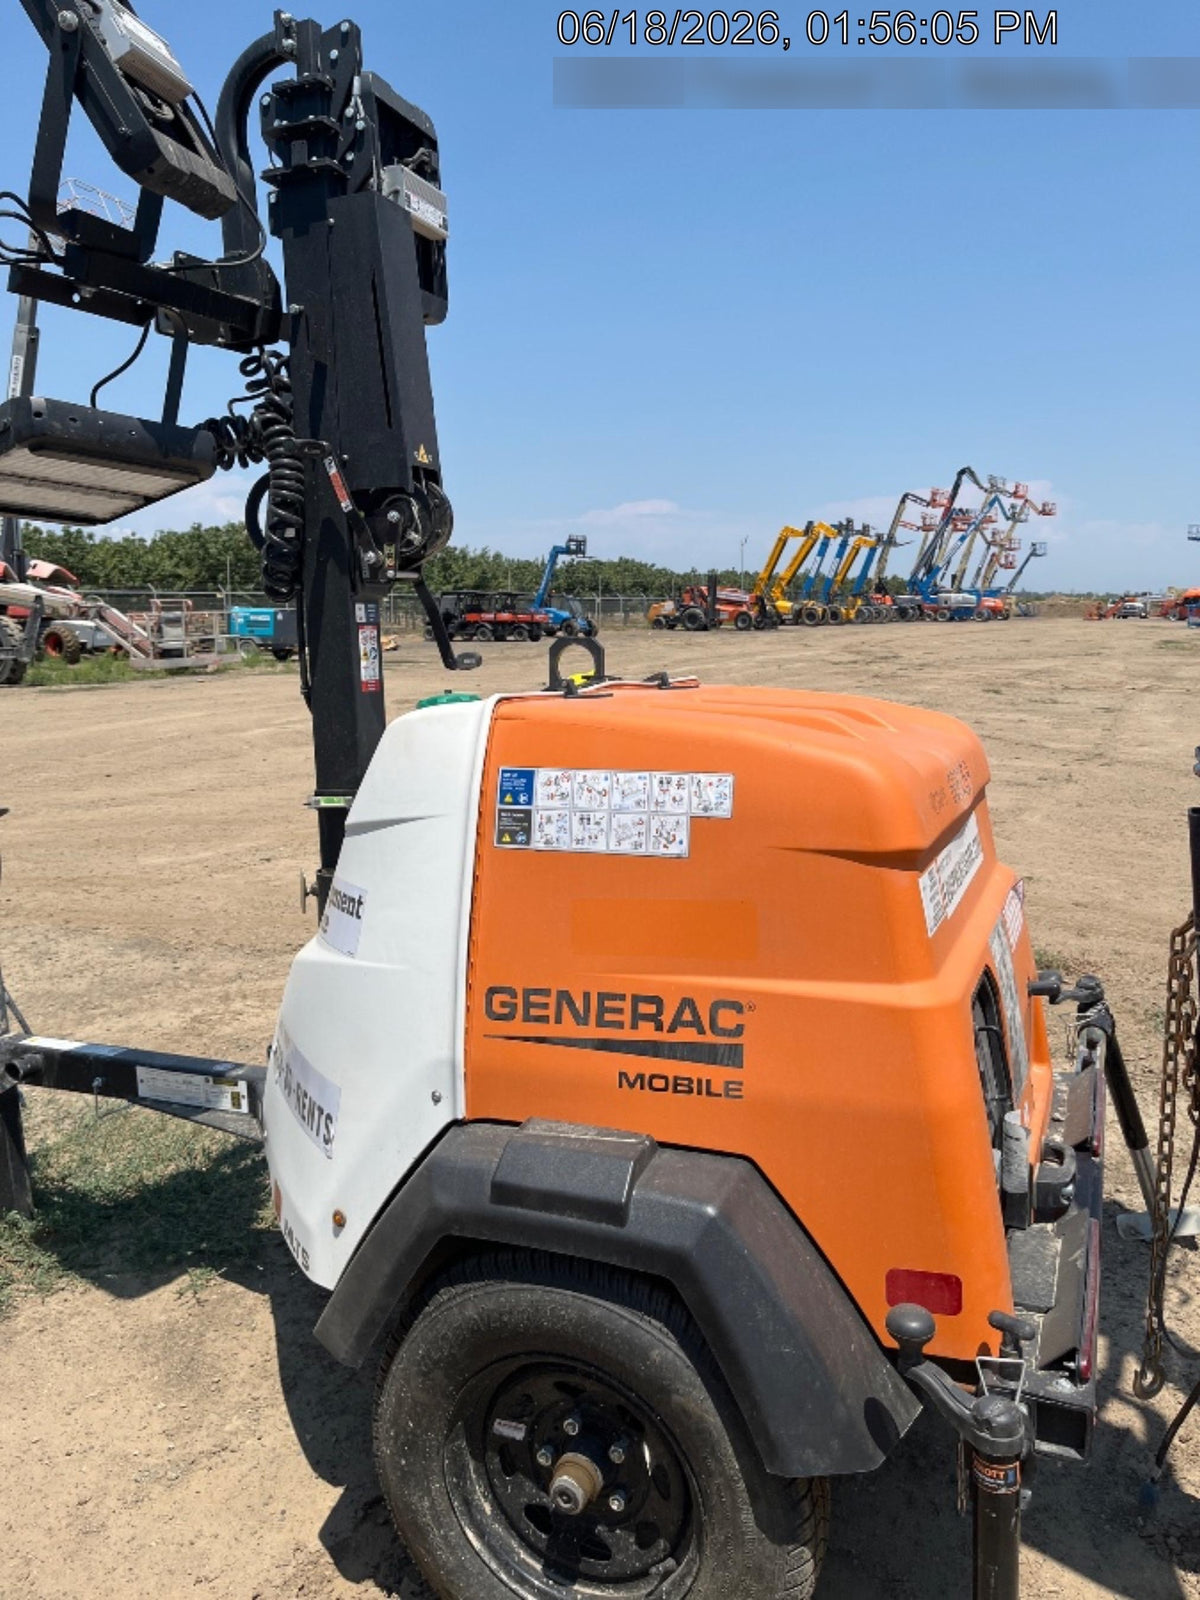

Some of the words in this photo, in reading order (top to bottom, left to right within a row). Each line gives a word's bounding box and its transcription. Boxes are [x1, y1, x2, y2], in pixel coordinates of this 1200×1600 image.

[329, 886, 364, 920] ment
[484, 986, 745, 1038] GENERAC
[618, 1071, 744, 1099] MOBILE
